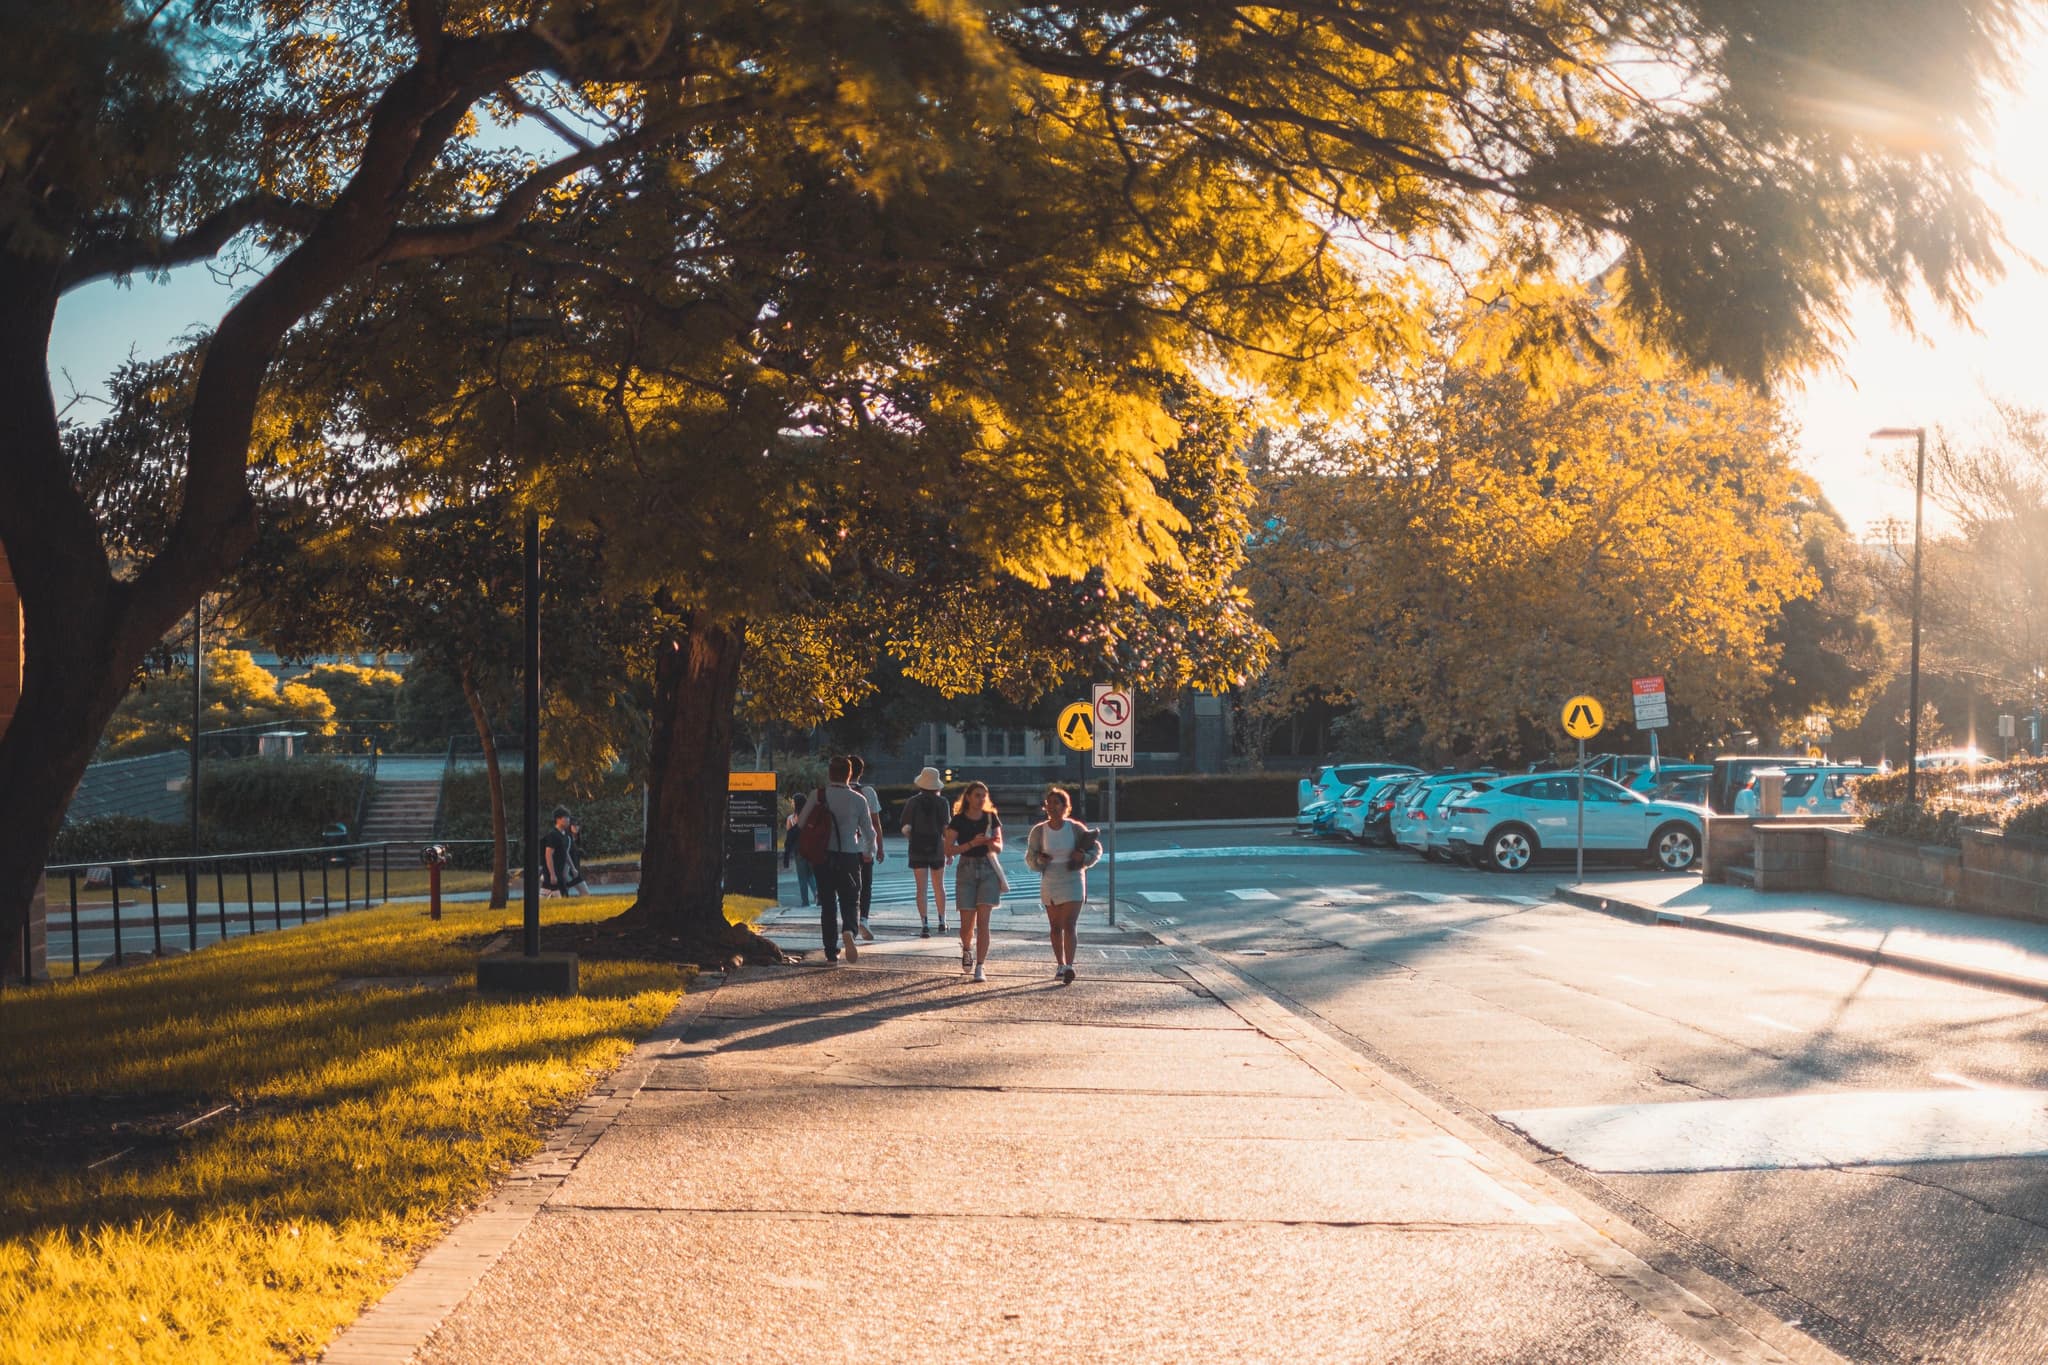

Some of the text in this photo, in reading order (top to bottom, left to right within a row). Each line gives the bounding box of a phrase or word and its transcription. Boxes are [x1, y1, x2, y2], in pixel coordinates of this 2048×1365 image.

[1105, 732, 1121, 740] NO
[1100, 743, 1126, 751] LEFT
[1098, 755, 1128, 763] TURN
